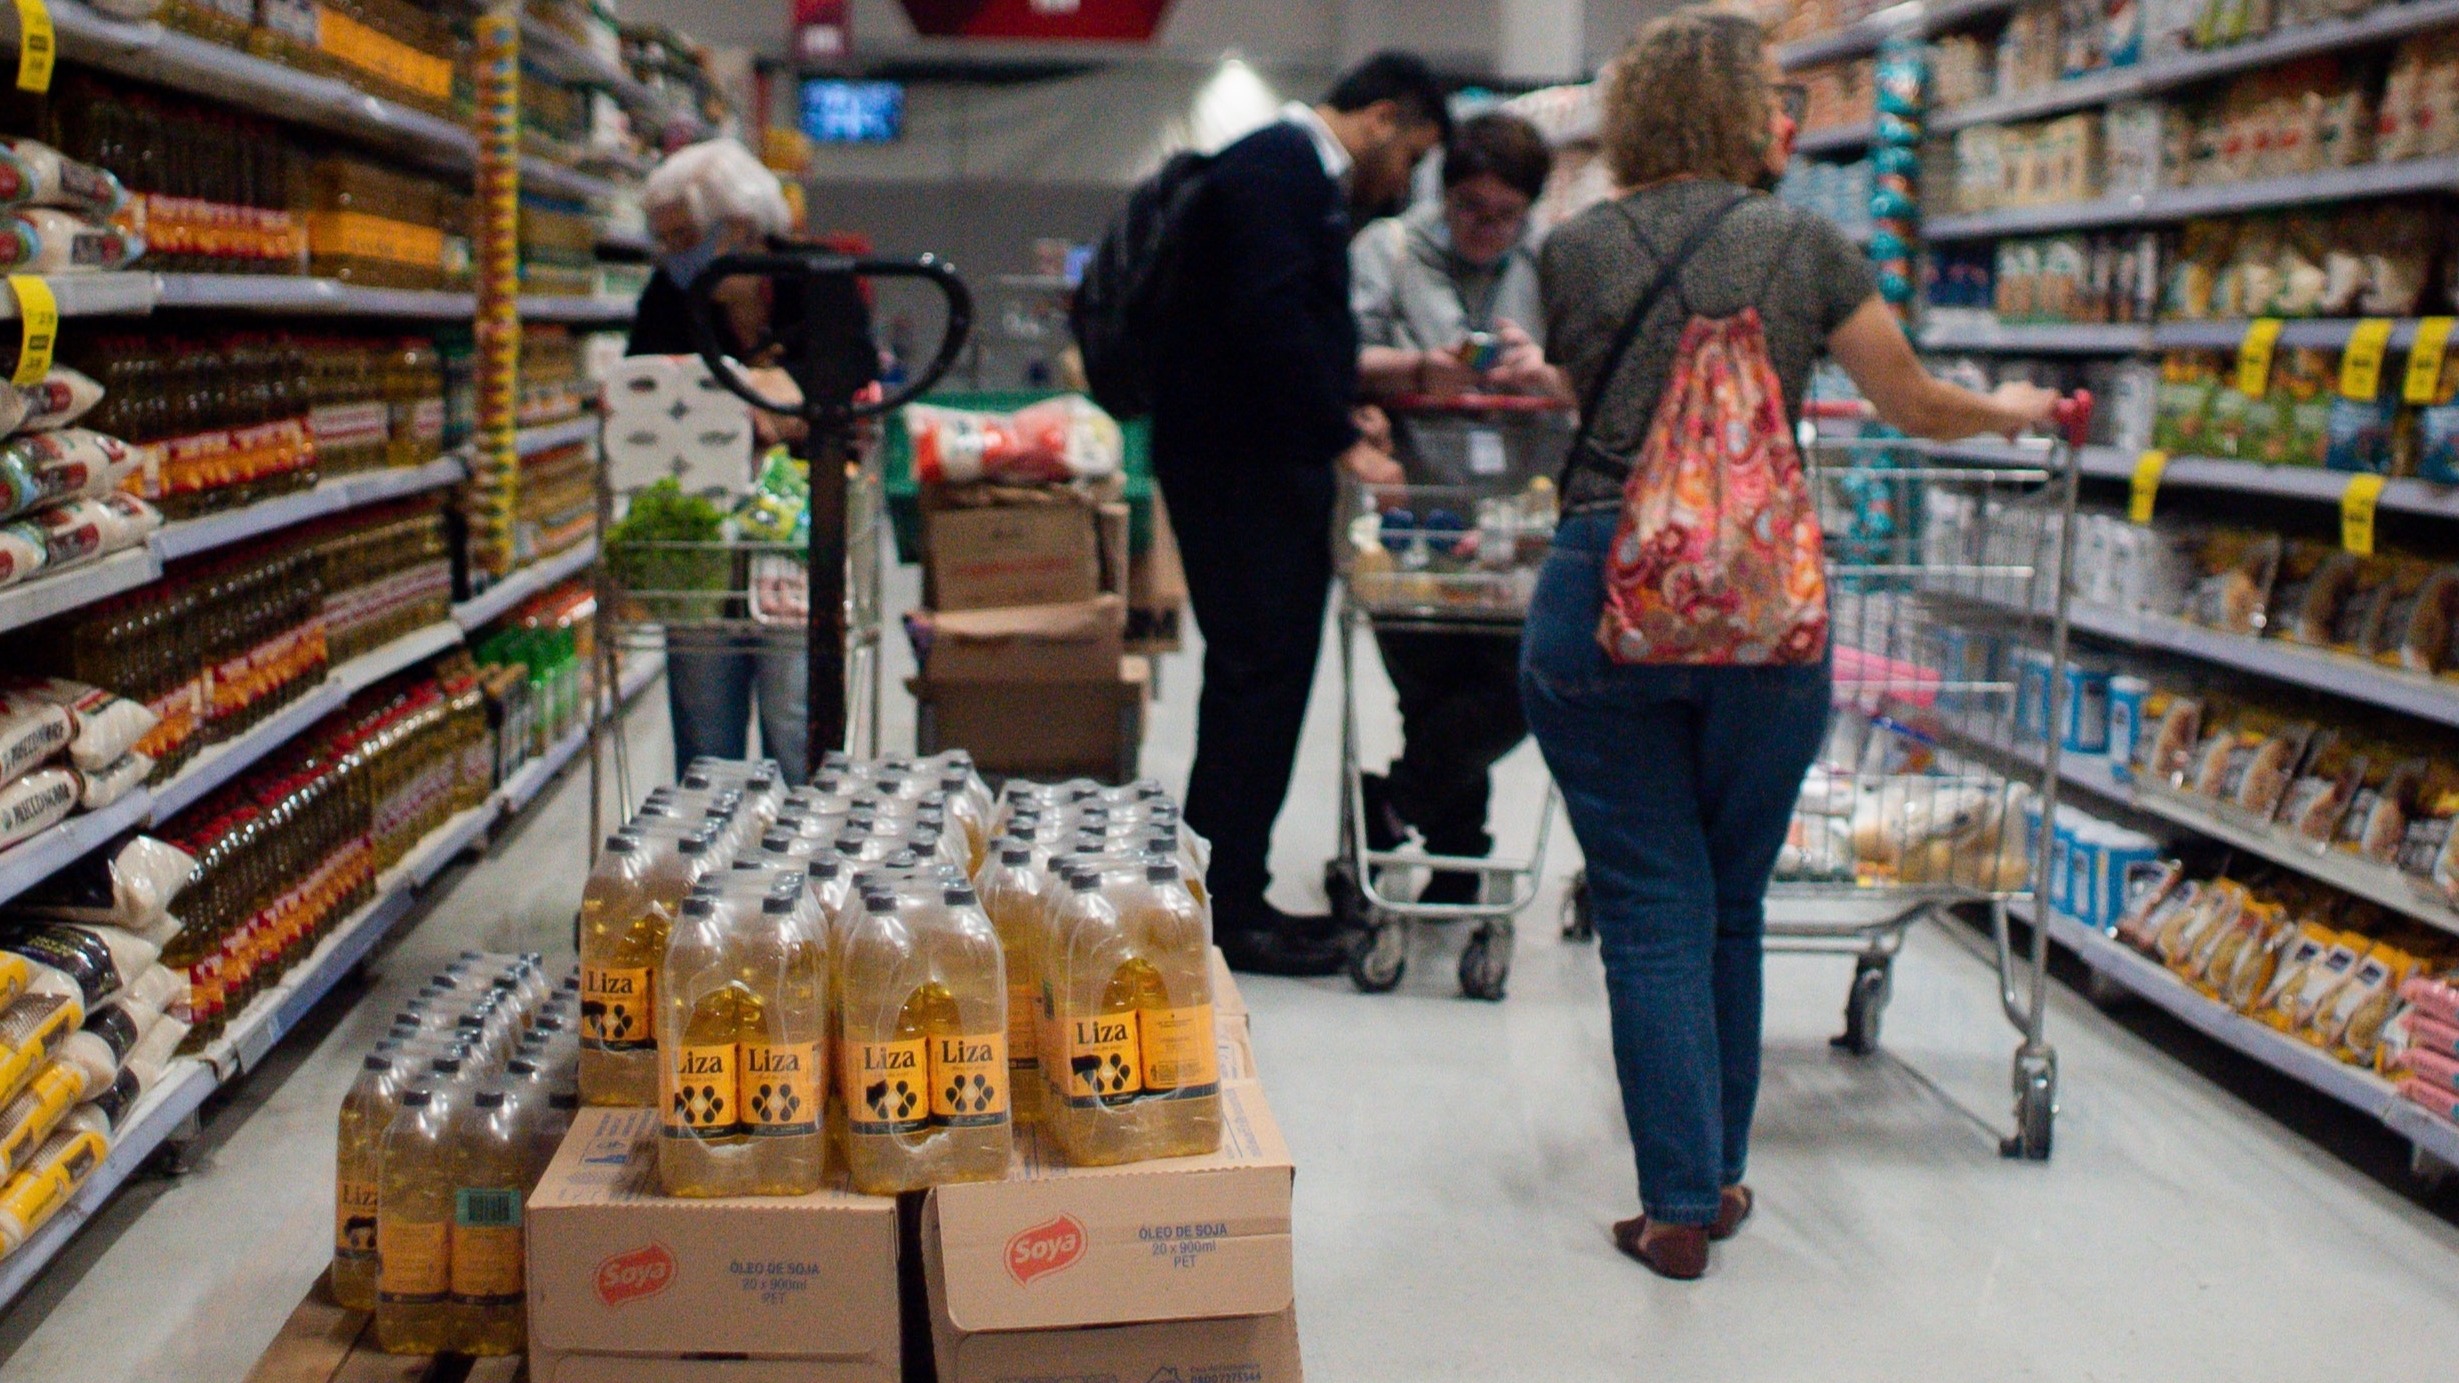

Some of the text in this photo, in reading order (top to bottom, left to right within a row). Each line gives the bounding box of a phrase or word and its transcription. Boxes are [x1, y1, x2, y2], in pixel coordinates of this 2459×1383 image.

[587, 971, 633, 994] Liza
[1076, 1020, 1129, 1045] Liza
[749, 1048, 800, 1072] Liza
[864, 1046, 917, 1070] Liza
[942, 1040, 993, 1063] Liza
[1138, 1223, 1228, 1240] ÓLEO DE SOJA
[1015, 1233, 1077, 1263] Soya
[1152, 1240, 1217, 1256] 20 x 900ml
[767, 1262, 784, 1274] DE
[788, 1262, 821, 1276] SOJA
[1174, 1253, 1197, 1269] PET
[606, 1262, 666, 1288] Soya
